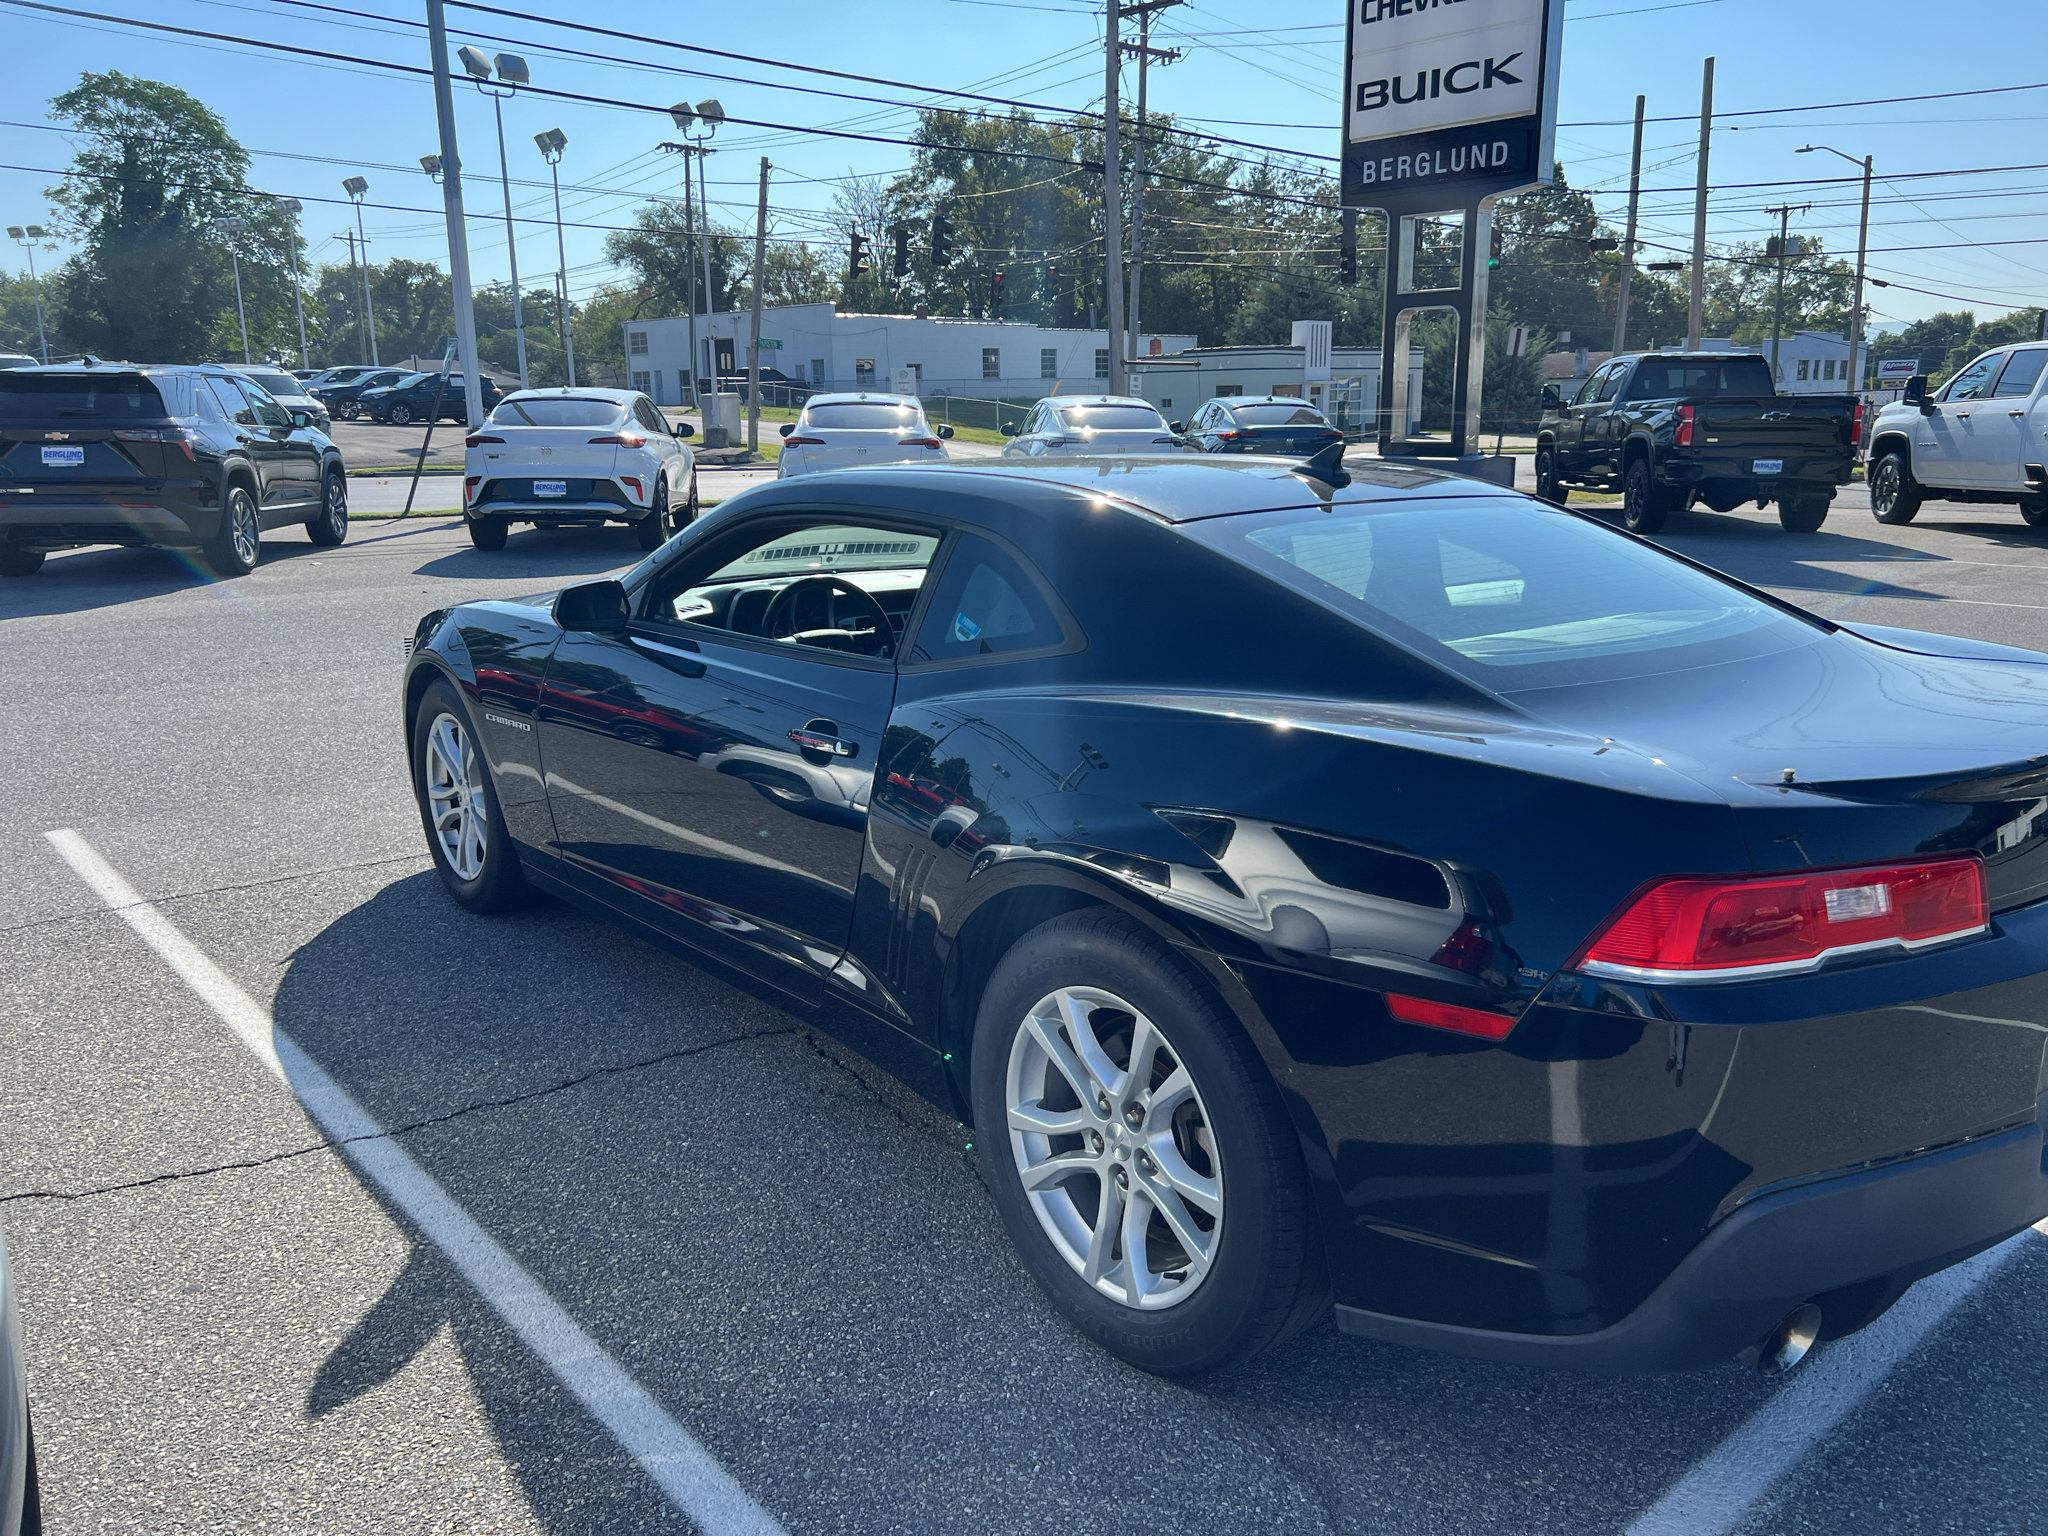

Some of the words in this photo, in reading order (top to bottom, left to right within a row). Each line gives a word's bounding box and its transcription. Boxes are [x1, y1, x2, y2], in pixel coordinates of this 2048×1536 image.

[1356, 51, 1523, 112] BUICK
[1362, 141, 1508, 184] BERGLUND
[43, 450, 83, 459] BERGLUND
[535, 484, 566, 492] BERGLUND
[485, 713, 531, 731] CAMARO
